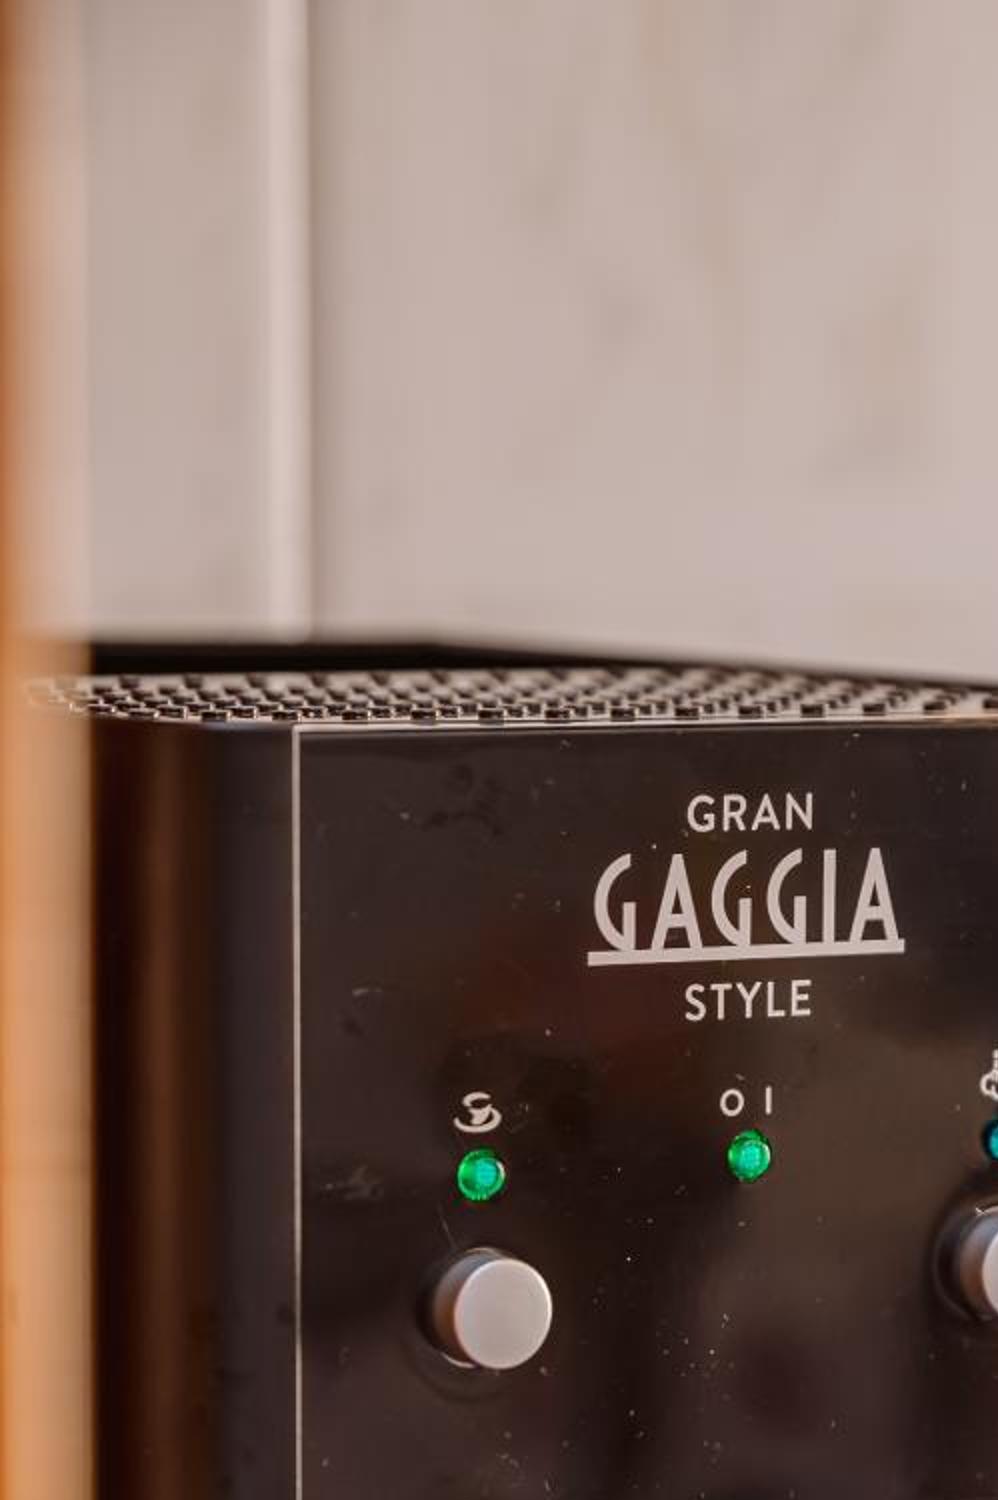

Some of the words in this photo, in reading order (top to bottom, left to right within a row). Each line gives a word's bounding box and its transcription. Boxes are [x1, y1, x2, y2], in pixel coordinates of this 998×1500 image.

[686, 792, 814, 832] GRAN
[588, 847, 905, 966] GAGGIA
[684, 979, 812, 1022] STYLE
